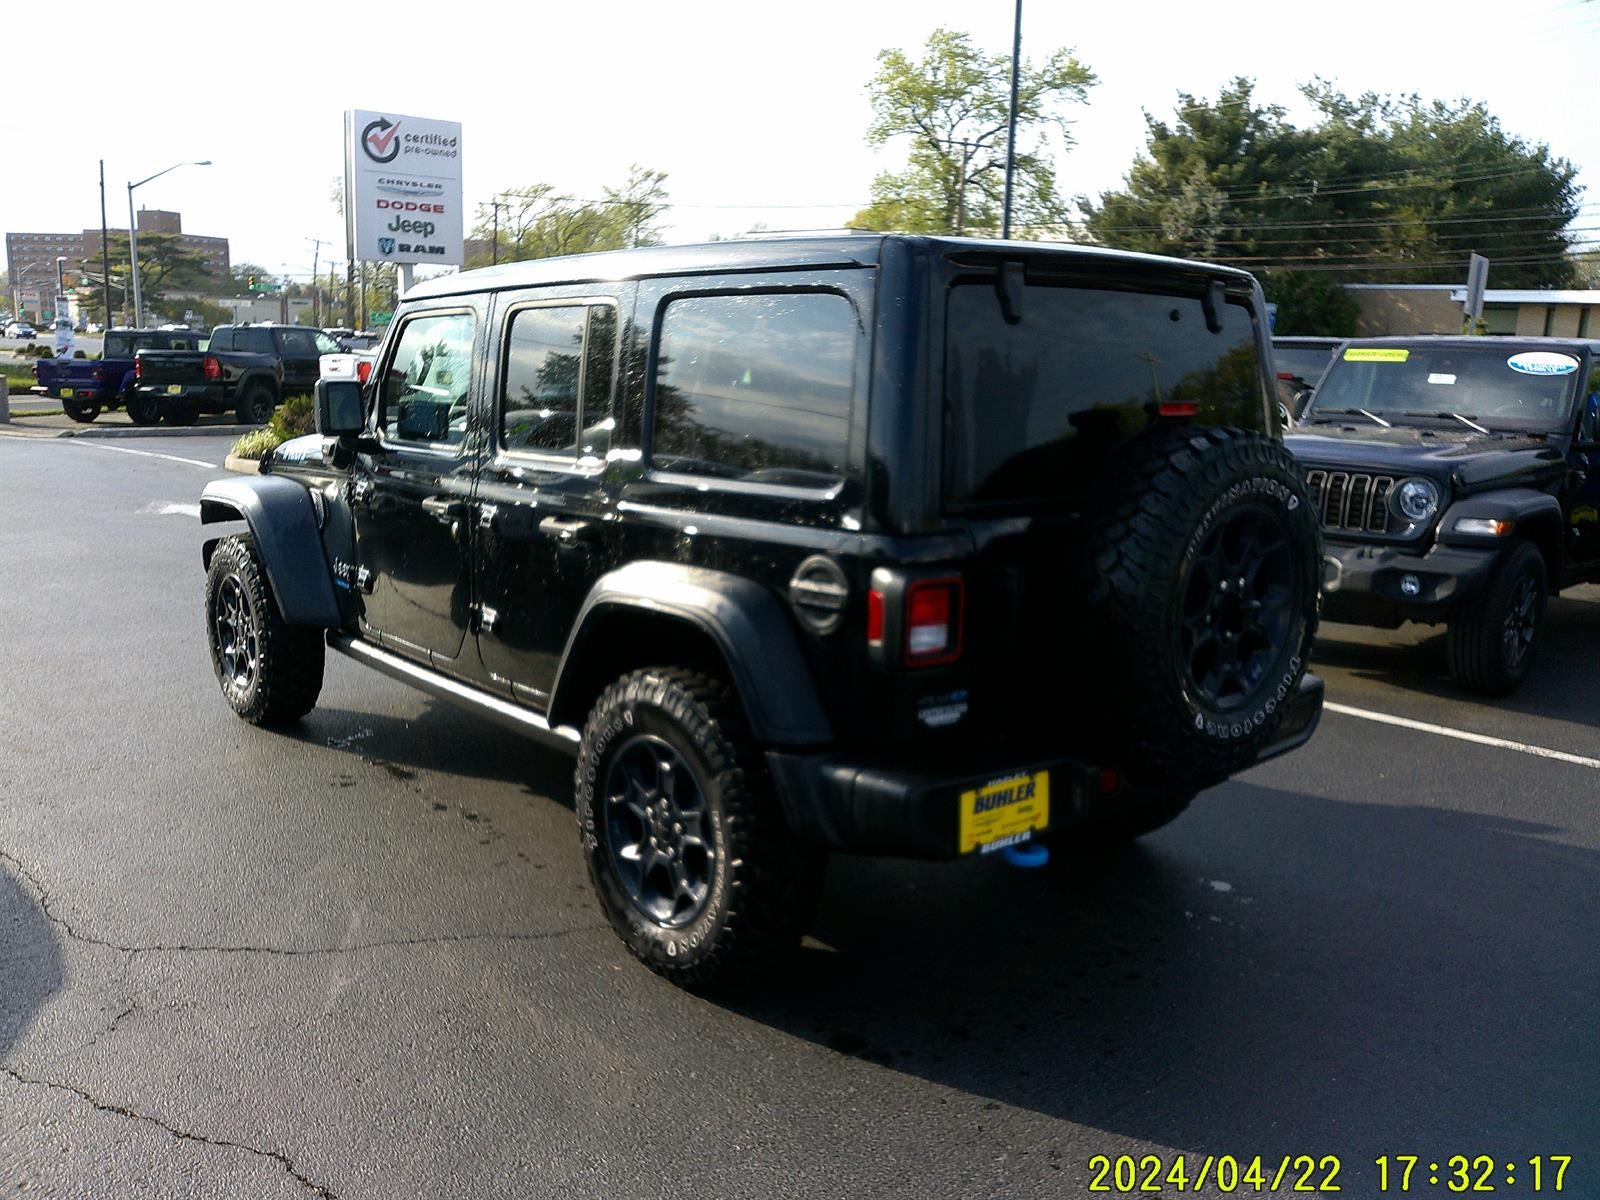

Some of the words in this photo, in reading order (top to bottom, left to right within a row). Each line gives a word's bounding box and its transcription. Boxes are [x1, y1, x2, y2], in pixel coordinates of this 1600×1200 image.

[404, 132, 457, 148] certified
[404, 145, 457, 158] pre-owned
[377, 177, 443, 190] CHRYSLER
[376, 199, 445, 214] DODGE
[387, 215, 435, 238] Jeep
[397, 243, 446, 255] RAM
[973, 781, 1036, 815] BUHLER
[980, 830, 1032, 854] BUHLER
